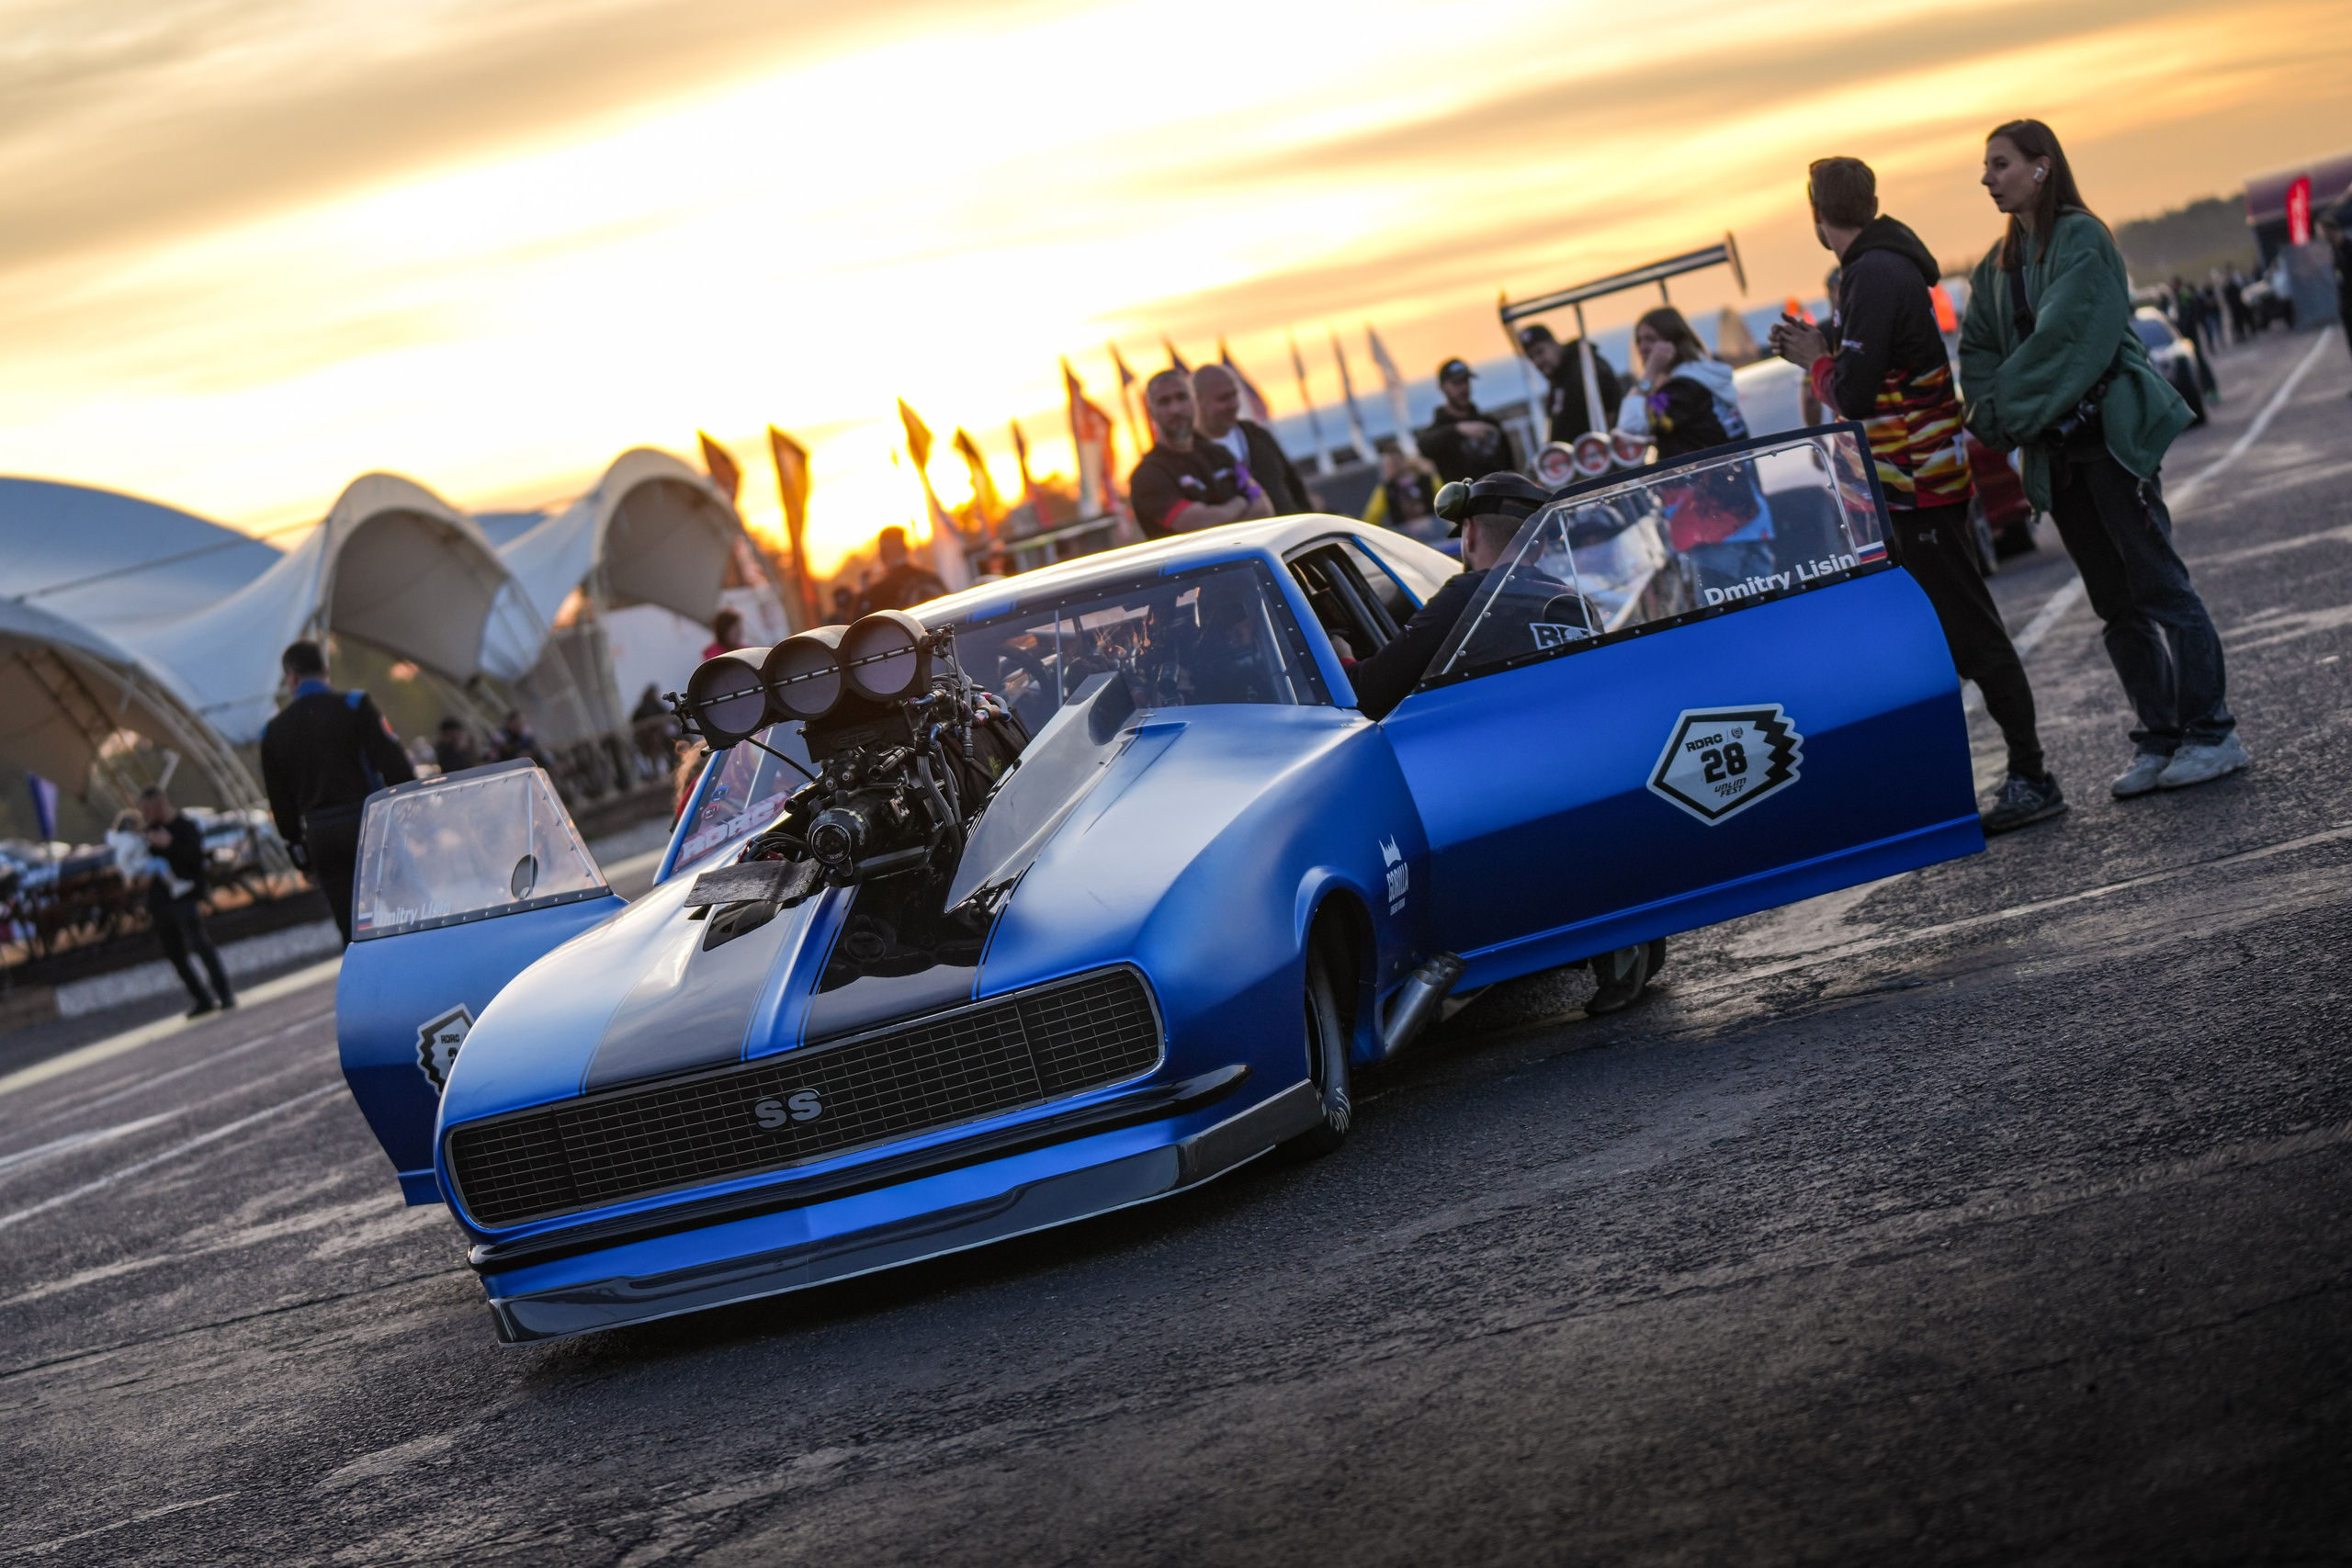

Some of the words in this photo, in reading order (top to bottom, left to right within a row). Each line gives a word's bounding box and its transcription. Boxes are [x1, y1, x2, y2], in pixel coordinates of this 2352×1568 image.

[1703, 571, 1791, 605] Dmitry
[1795, 554, 1856, 581] Lisin
[1685, 733, 1724, 752] RDRC
[1701, 741, 1747, 784] 28
[1720, 784, 1744, 797] FEST
[683, 801, 775, 862] RDRC
[755, 1090, 822, 1129] SS
